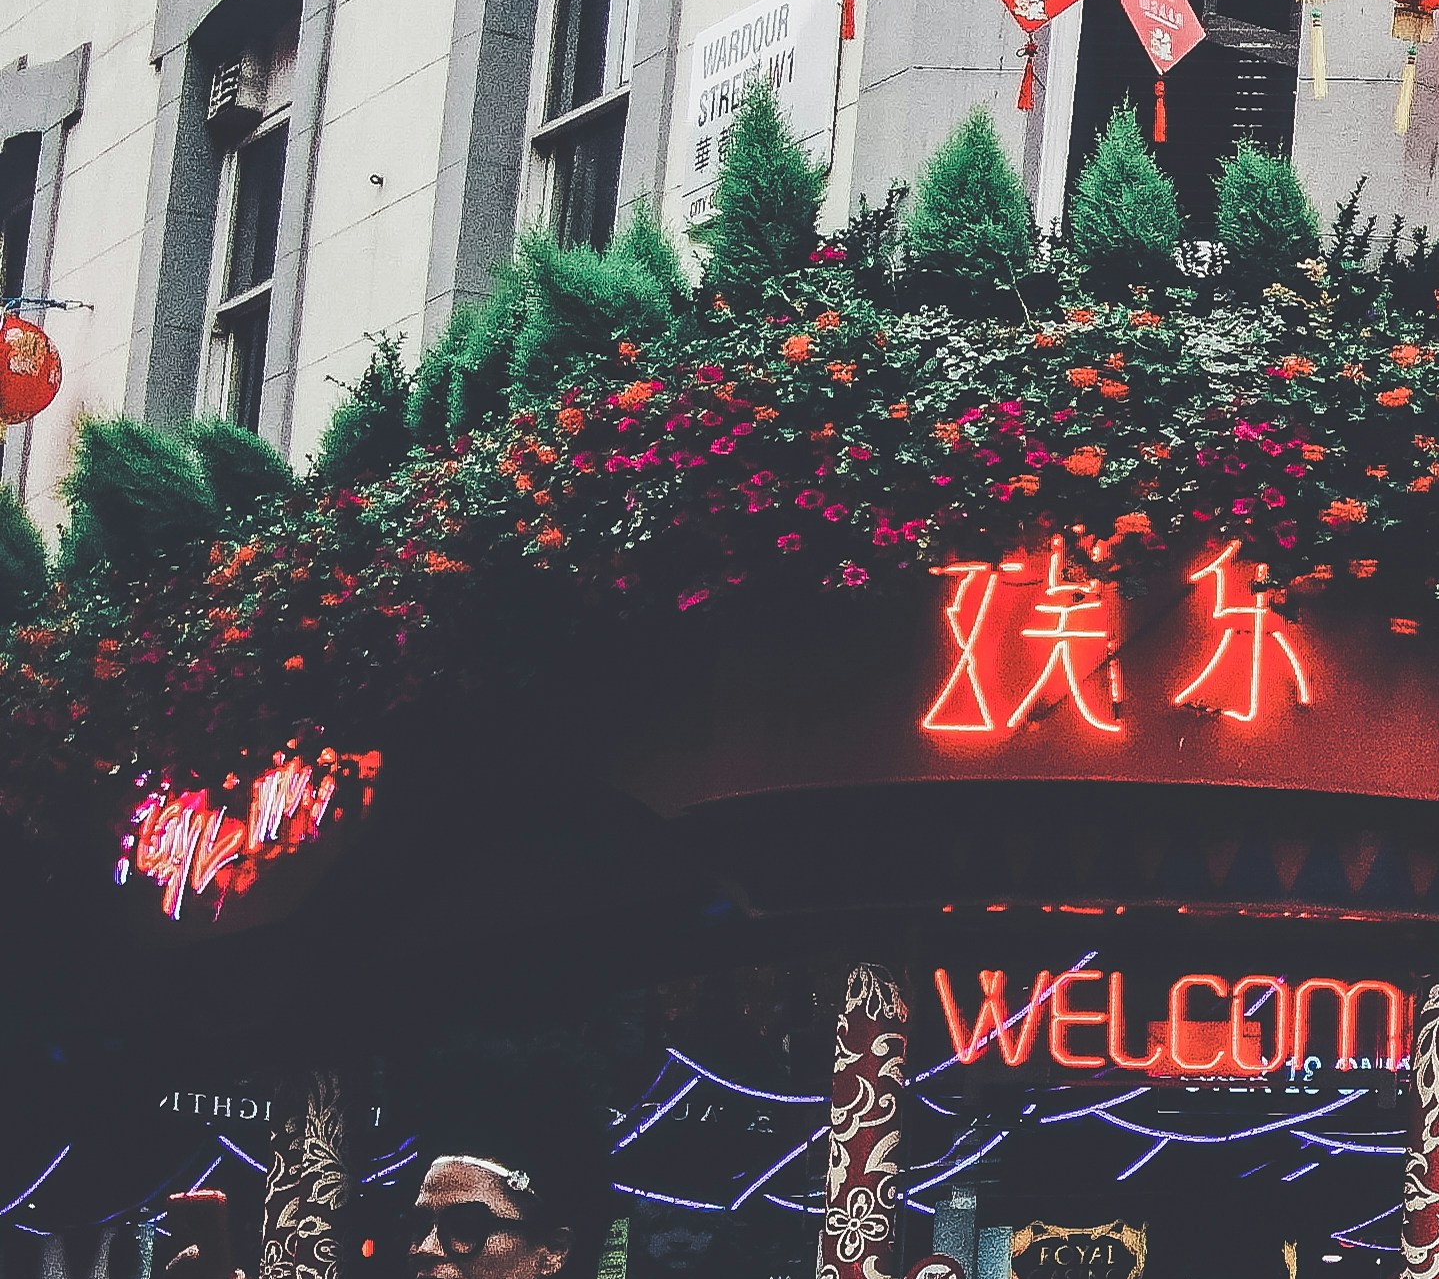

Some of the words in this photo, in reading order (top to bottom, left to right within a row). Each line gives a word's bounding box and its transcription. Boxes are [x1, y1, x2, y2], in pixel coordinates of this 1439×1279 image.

[703, 3, 790, 79] WARDOUR
[690, 196, 708, 218] CITY
[1039, 1244, 1117, 1266] ROYAL
